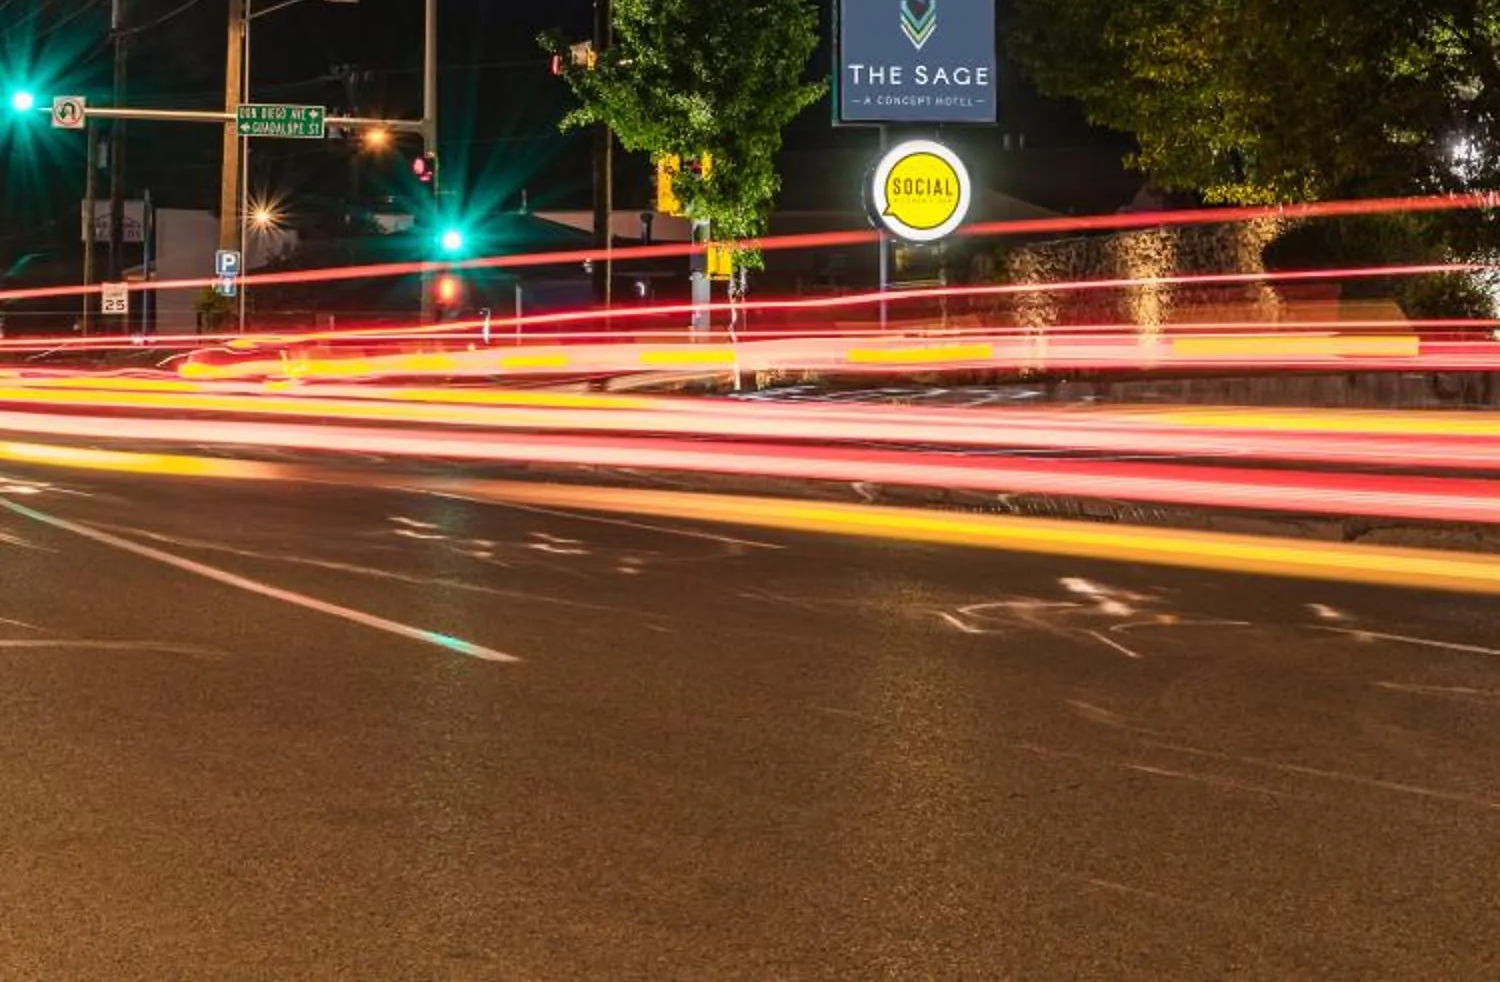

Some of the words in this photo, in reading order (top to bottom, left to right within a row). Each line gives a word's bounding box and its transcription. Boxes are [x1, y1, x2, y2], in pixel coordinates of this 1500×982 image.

[848, 64, 902, 86] THE
[915, 65, 989, 86] SAGE
[863, 97, 871, 106] A
[877, 96, 931, 106] CONCEPT
[935, 97, 974, 107] HOTEL
[893, 178, 953, 196] SOCIAL
[222, 254, 235, 272] P
[105, 299, 125, 311] 25
